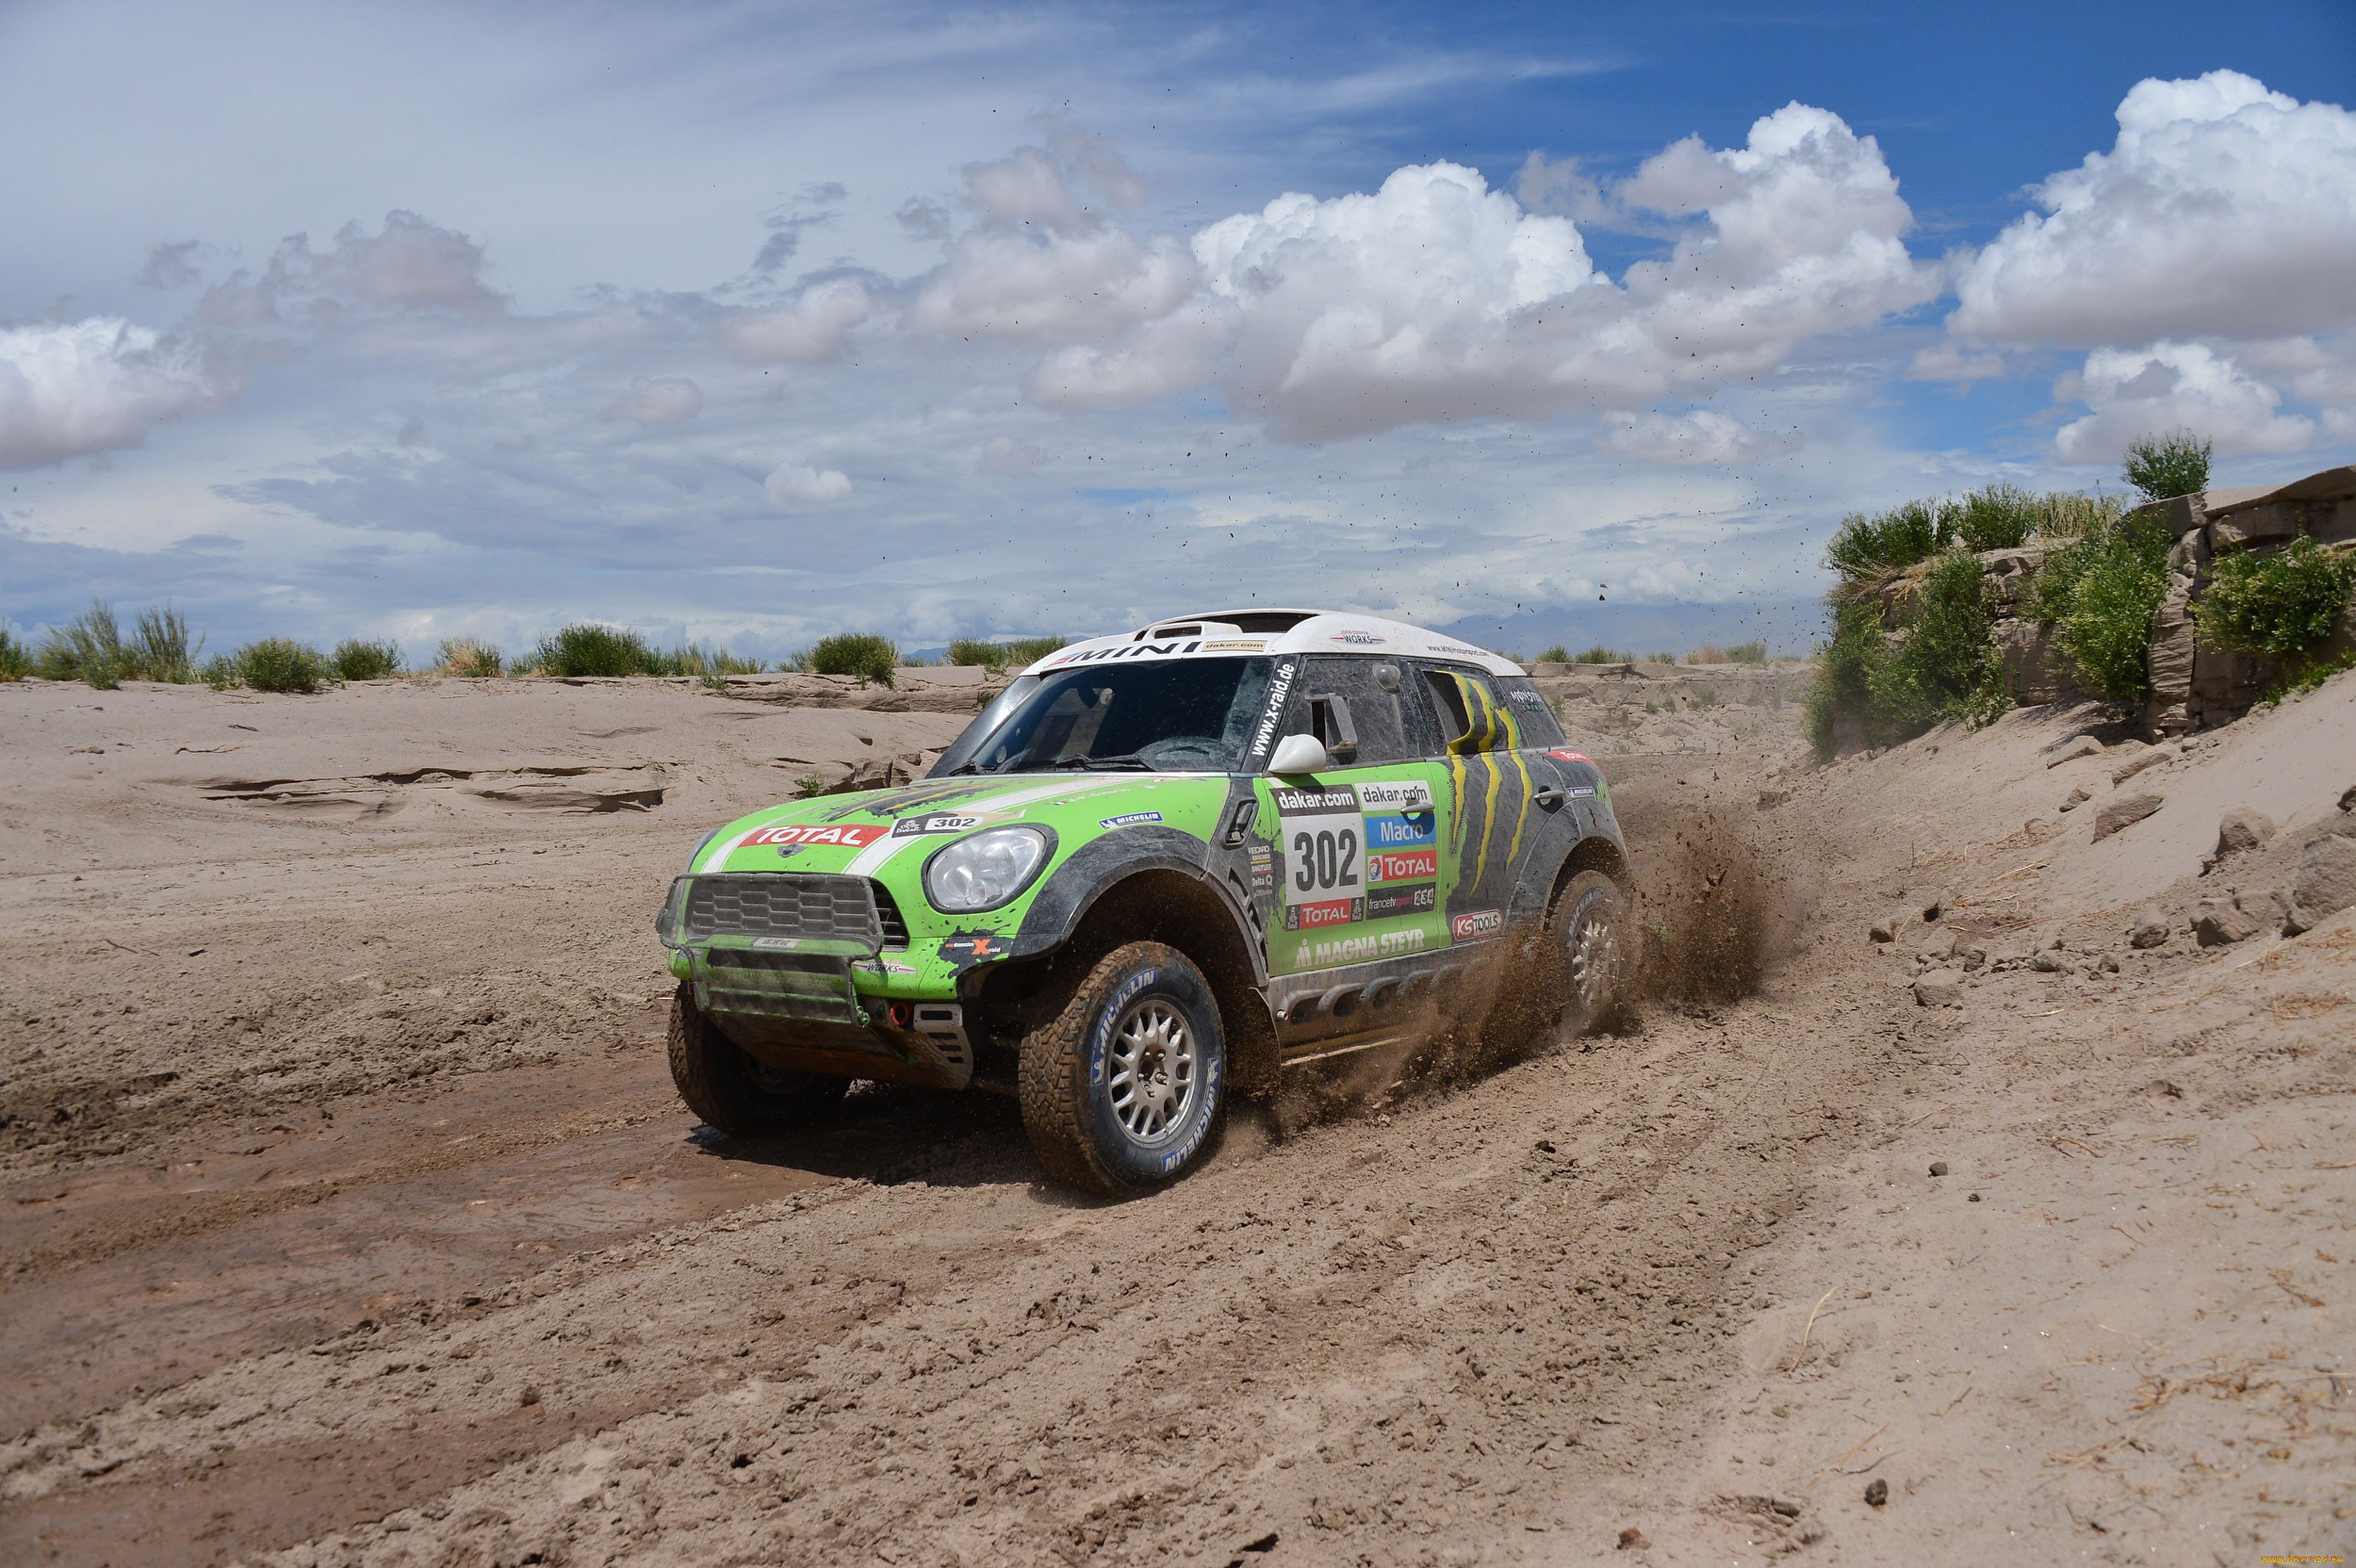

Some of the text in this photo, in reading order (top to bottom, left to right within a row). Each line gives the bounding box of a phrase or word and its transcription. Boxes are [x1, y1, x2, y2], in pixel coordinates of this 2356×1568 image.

[1343, 635, 1372, 643] WORKS
[1068, 642, 1202, 663] MINI
[1251, 663, 1295, 757] www.x-raid.de
[1279, 792, 1355, 809] dakar.com
[1363, 787, 1428, 803] dakar.com
[934, 818, 976, 827] 302
[1117, 812, 1158, 824] MICHELIN
[757, 826, 863, 845] TOTAL
[1381, 821, 1424, 842] Macro
[1248, 845, 1270, 854] RECARO
[1294, 828, 1358, 892] 302
[1384, 857, 1435, 876] TOTAL
[1251, 877, 1265, 887] Delta
[1303, 907, 1348, 923] TOTAL
[1473, 914, 1498, 932] TOOLS
[1314, 928, 1425, 965] MAGNA STEYR
[867, 963, 899, 973] WORKS
[1099, 969, 1155, 1054] MICHELIN
[1164, 1086, 1216, 1173] MICHELIN
